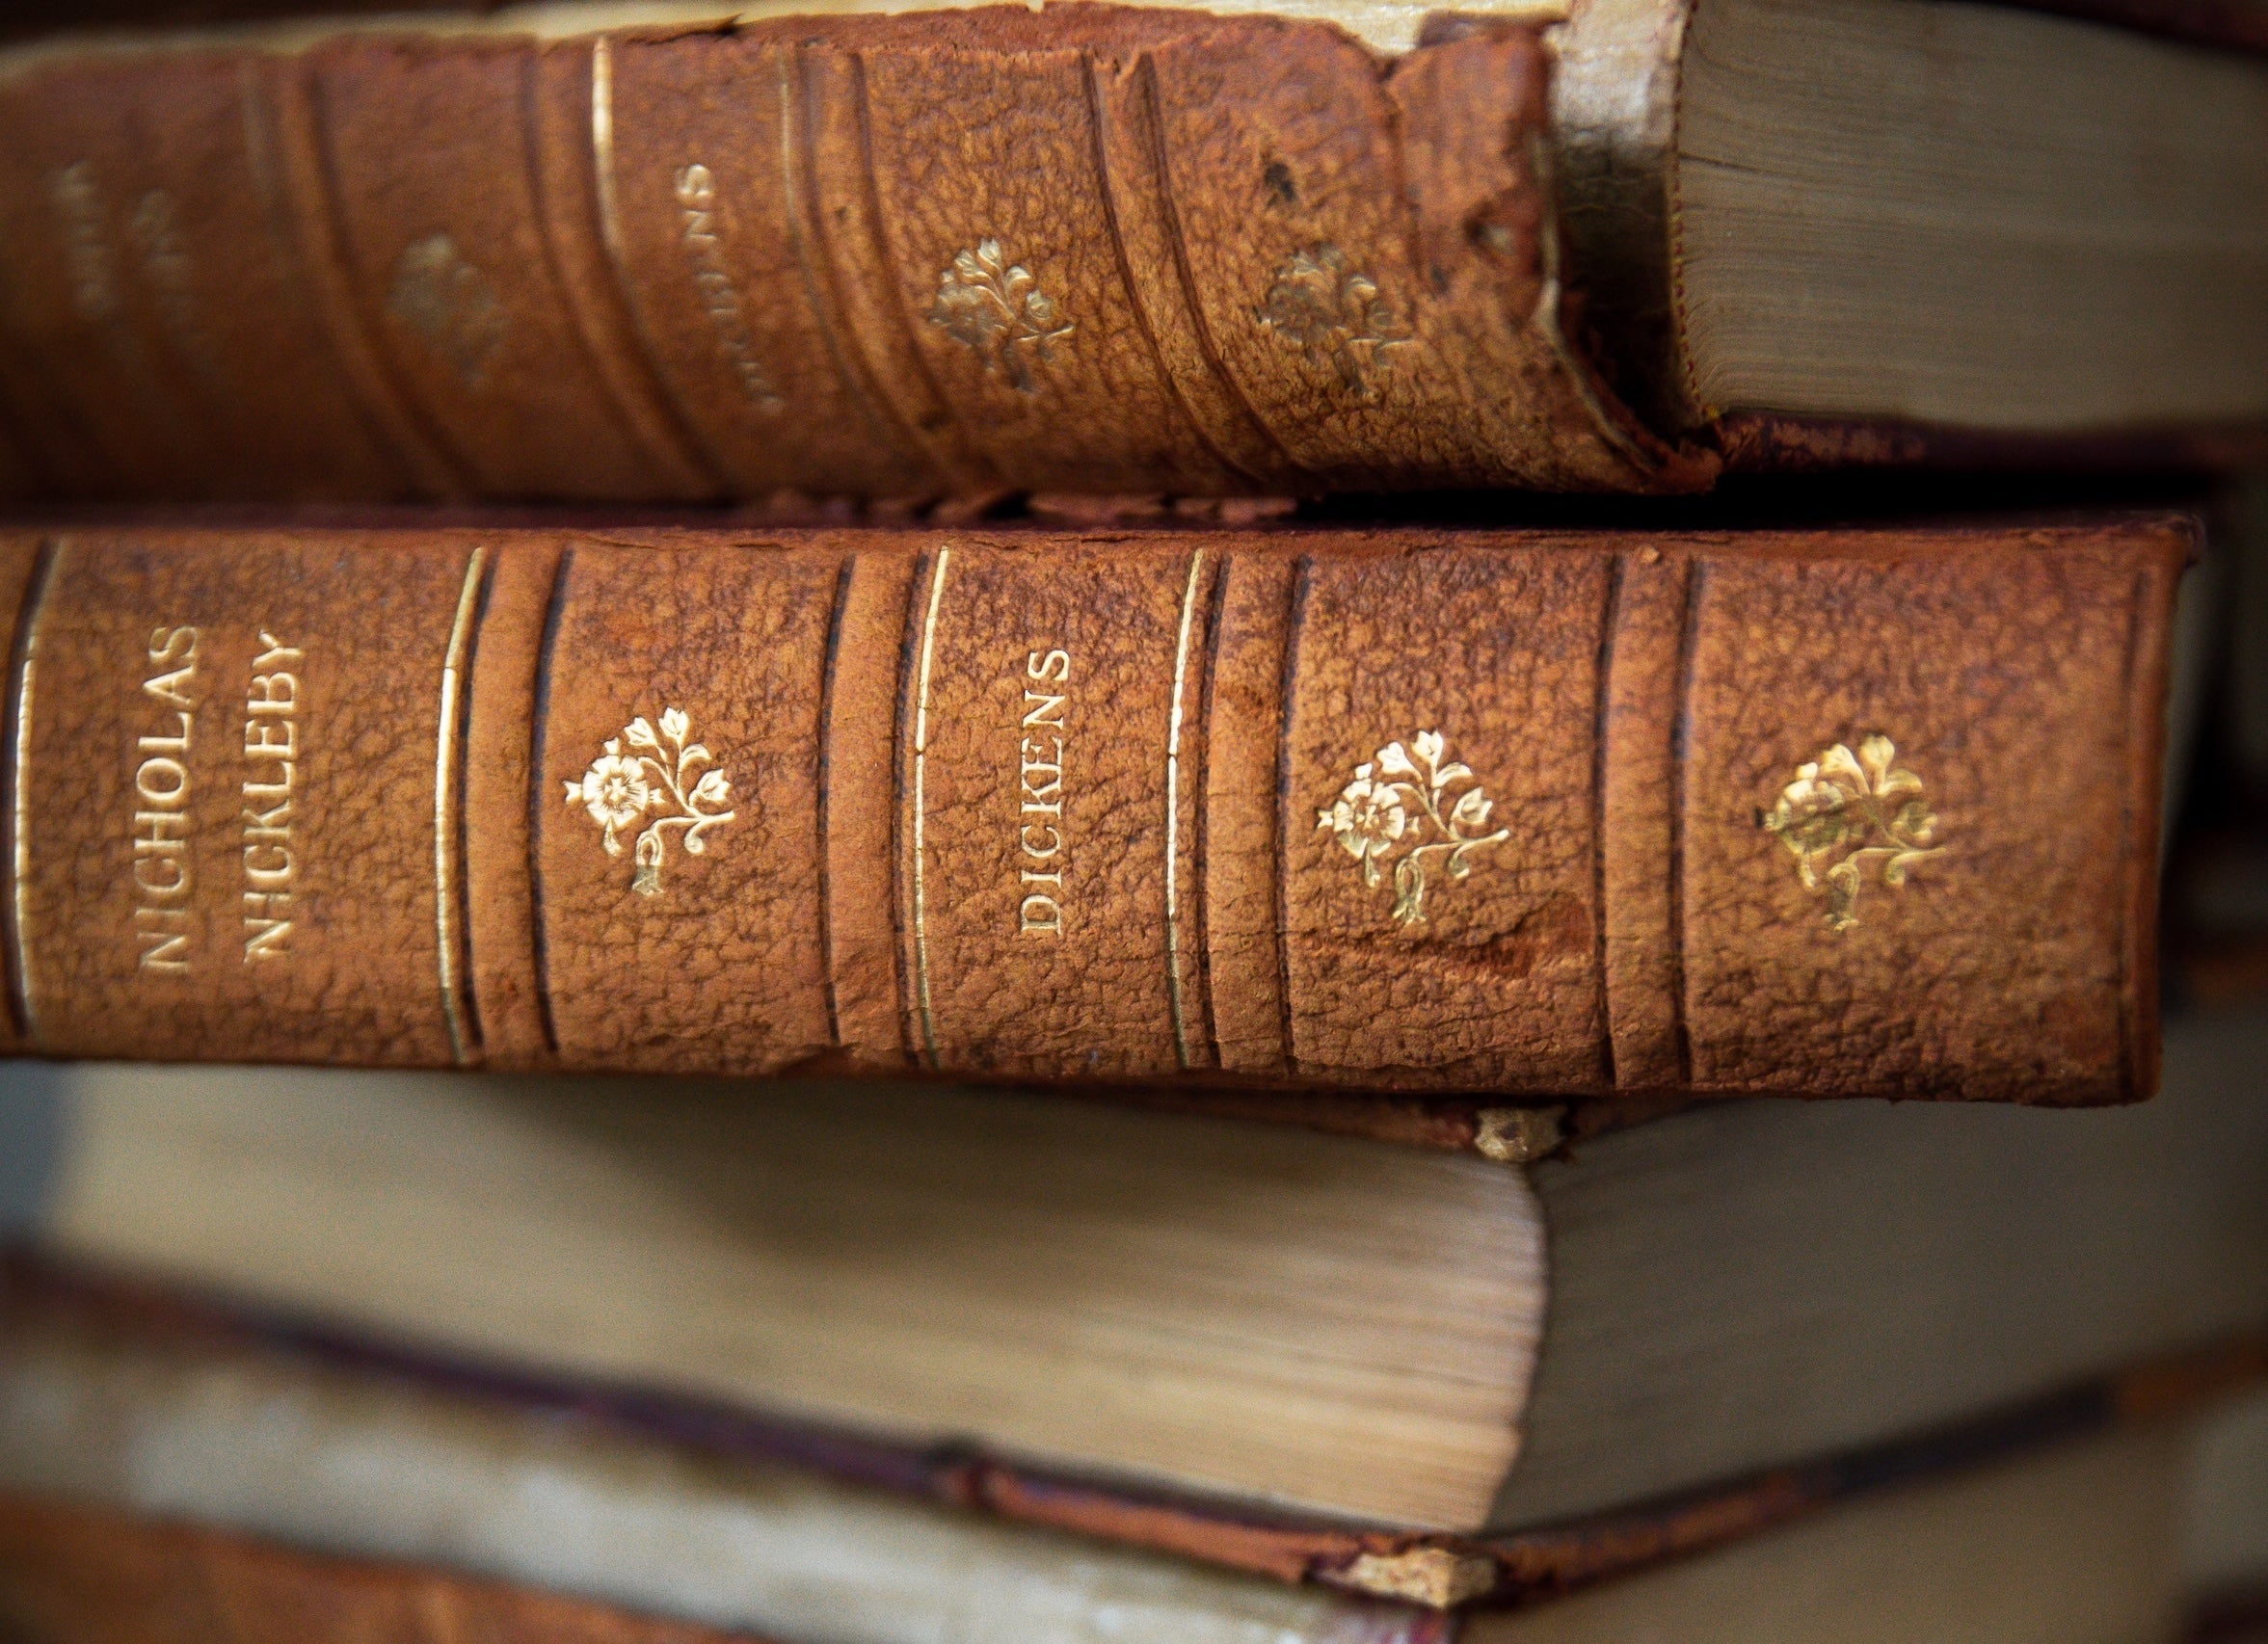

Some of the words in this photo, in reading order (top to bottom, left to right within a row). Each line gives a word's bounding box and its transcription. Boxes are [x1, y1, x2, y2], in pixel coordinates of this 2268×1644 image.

[133, 624, 199, 975] NICHOLAS
[243, 628, 304, 966] NICKLEBY
[1020, 649, 1070, 936] DICKENS
